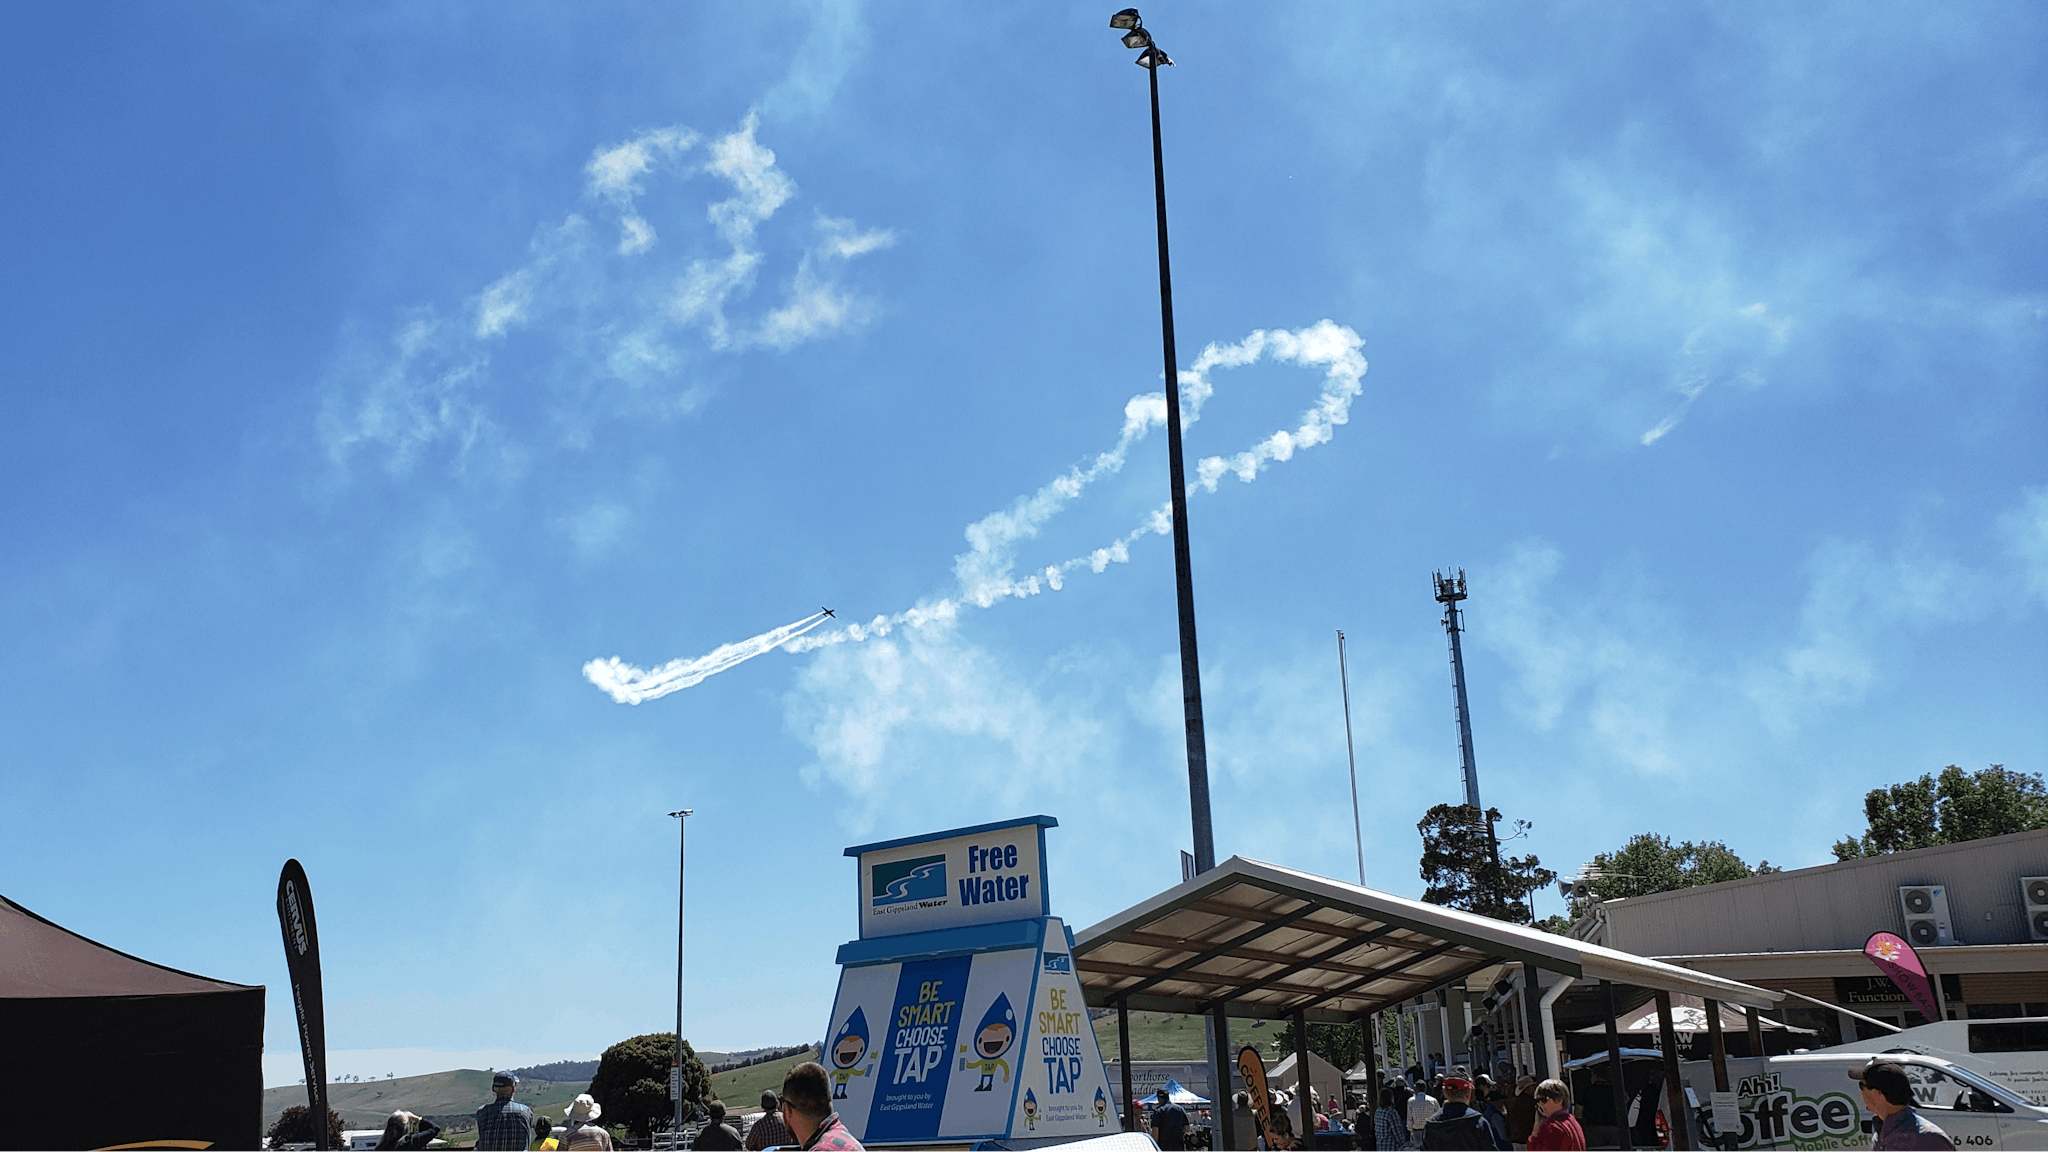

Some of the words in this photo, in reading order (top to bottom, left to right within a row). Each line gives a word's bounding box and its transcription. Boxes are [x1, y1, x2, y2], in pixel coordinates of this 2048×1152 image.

[968, 844, 1018, 873] Free
[959, 874, 1029, 906] Water
[286, 879, 307, 956] CERVUS
[872, 907, 886, 915] East
[886, 903, 918, 914] Gippsland
[918, 900, 948, 909] Water
[1888, 962, 1918, 992] SHOW
[918, 980, 943, 1004] BE
[1050, 988, 1067, 1011] BE
[1847, 990, 1906, 1003] Function
[898, 1001, 955, 1027] SMART
[1038, 1012, 1081, 1034] SMART
[895, 1026, 948, 1048] CHOOSE
[1042, 1037, 1081, 1056] CHOOSE
[1652, 1032, 1694, 1045] RW
[984, 1062, 995, 1071] TAP
[886, 1093, 907, 1102] brought
[914, 1094, 924, 1102] you
[924, 1092, 931, 1101] by
[1240, 1064, 1270, 1131] COFFEE
[1795, 1138, 1839, 1152] Mobile
[1841, 1134, 1873, 1148] Coff
[1965, 1135, 1993, 1146] 406
